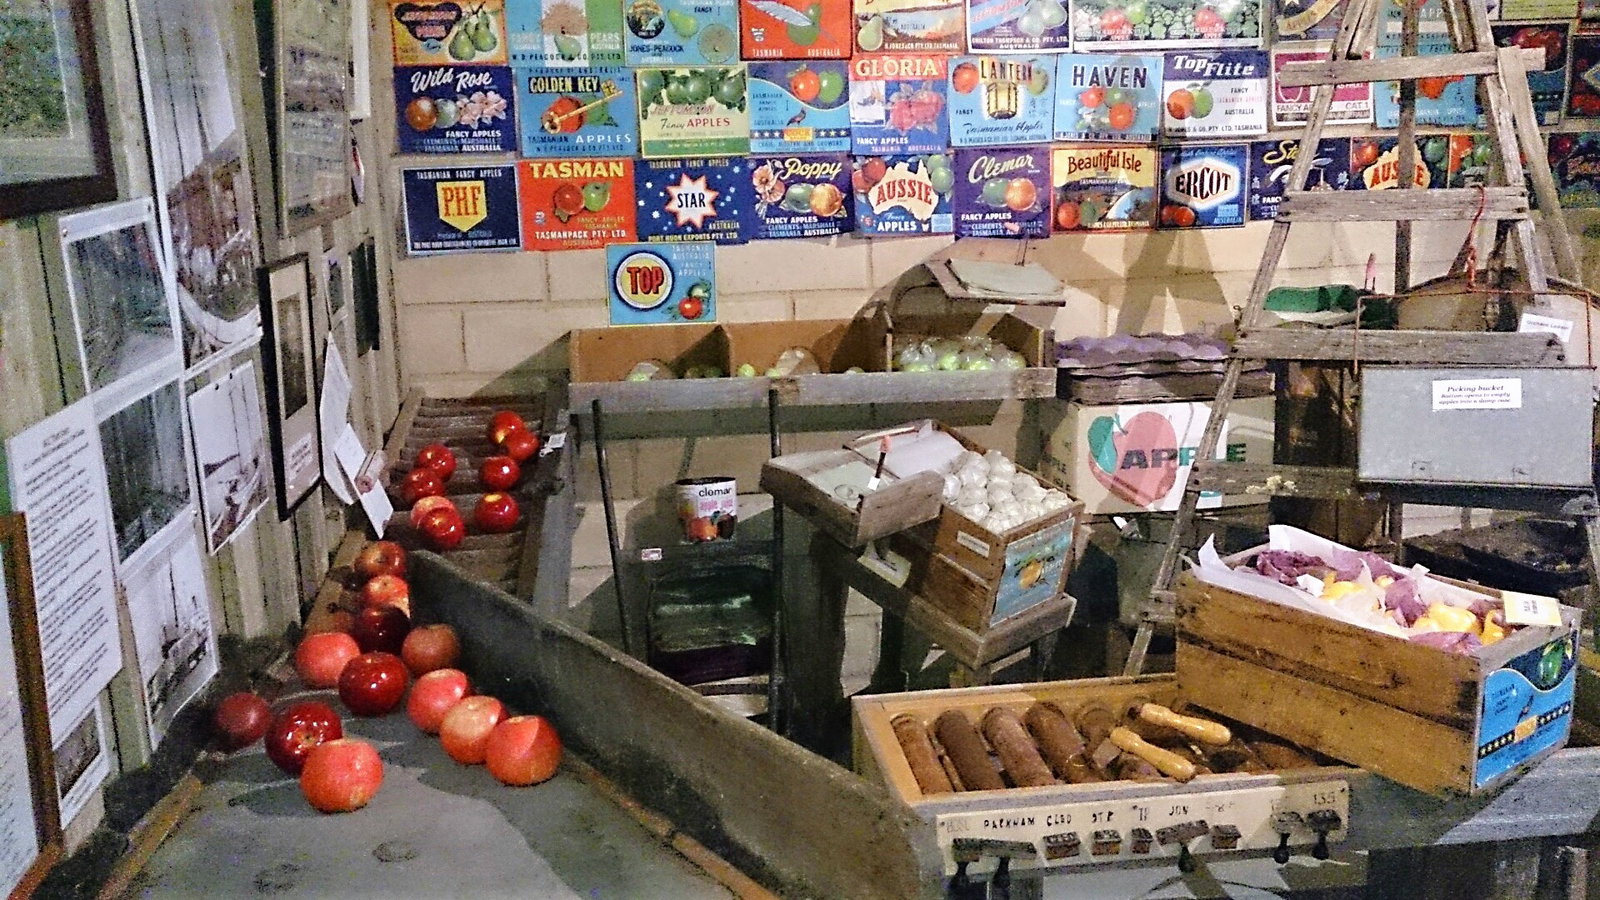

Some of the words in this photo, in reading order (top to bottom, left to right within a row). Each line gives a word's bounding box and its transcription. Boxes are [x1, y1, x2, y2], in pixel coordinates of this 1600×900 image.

[856, 58, 938, 77] GLORIA
[981, 59, 1032, 82] LANTERN
[1174, 55, 1207, 73] Top
[1203, 62, 1254, 76] Flite
[410, 67, 454, 93] Wild
[455, 71, 492, 92] Rose
[1072, 65, 1148, 88] HAVEN
[529, 76, 572, 93] GOLDEN
[577, 76, 599, 93] KEY
[1225, 108, 1255, 116] AUSTRALIA
[687, 117, 731, 127] APPLES
[1235, 123, 1263, 131] TASMANIA
[472, 130, 502, 138] APPLES
[576, 133, 632, 144] APPLES
[649, 161, 682, 169] TASMANIAN
[708, 159, 730, 167] APPLES
[1067, 149, 1120, 175] Beautiful
[1121, 151, 1142, 172] Isle
[417, 171, 451, 180] TASMANIAN
[455, 170, 475, 178] FANCY
[480, 169, 502, 178] APPLES
[529, 161, 624, 178] TASMAN
[780, 157, 842, 181] Poppy
[968, 154, 1034, 184] Clemar
[1176, 166, 1232, 200] ERCOT
[876, 179, 932, 207] AUSSIE
[677, 192, 706, 208] STAR
[790, 216, 818, 224] APPLES
[985, 212, 1012, 220] APPLES
[709, 221, 740, 230] AUSTRALIA
[804, 228, 840, 236] AUSTRALIA
[877, 221, 917, 232] APPLES
[535, 231, 588, 239] TASMANPACK
[684, 233, 710, 241] EXPORTS
[678, 269, 706, 277] APPLES
[626, 265, 665, 295] TOP
[1121, 443, 1246, 470] APPE
